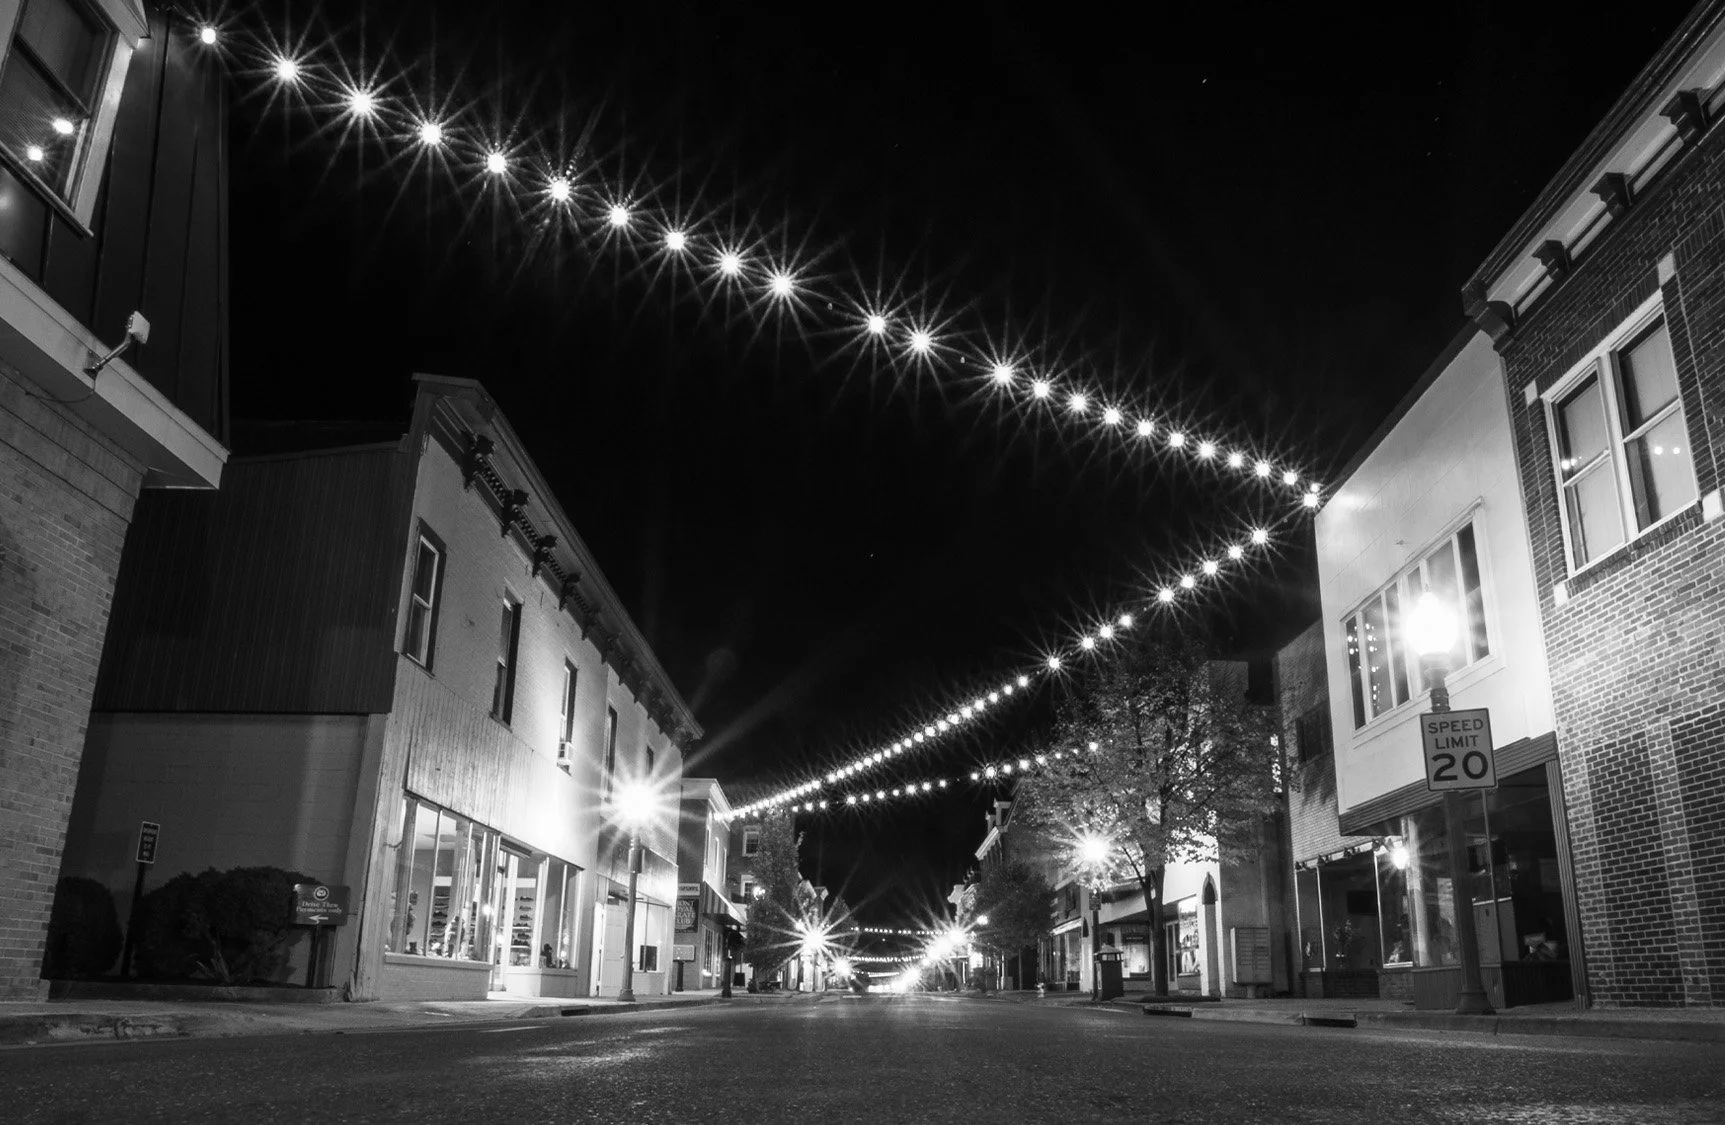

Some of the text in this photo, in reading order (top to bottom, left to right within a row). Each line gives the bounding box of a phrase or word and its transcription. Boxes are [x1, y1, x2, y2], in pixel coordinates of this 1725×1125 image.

[1428, 719, 1483, 734] SPEED
[1435, 735, 1478, 749] LIMIT
[1432, 750, 1488, 781] 20
